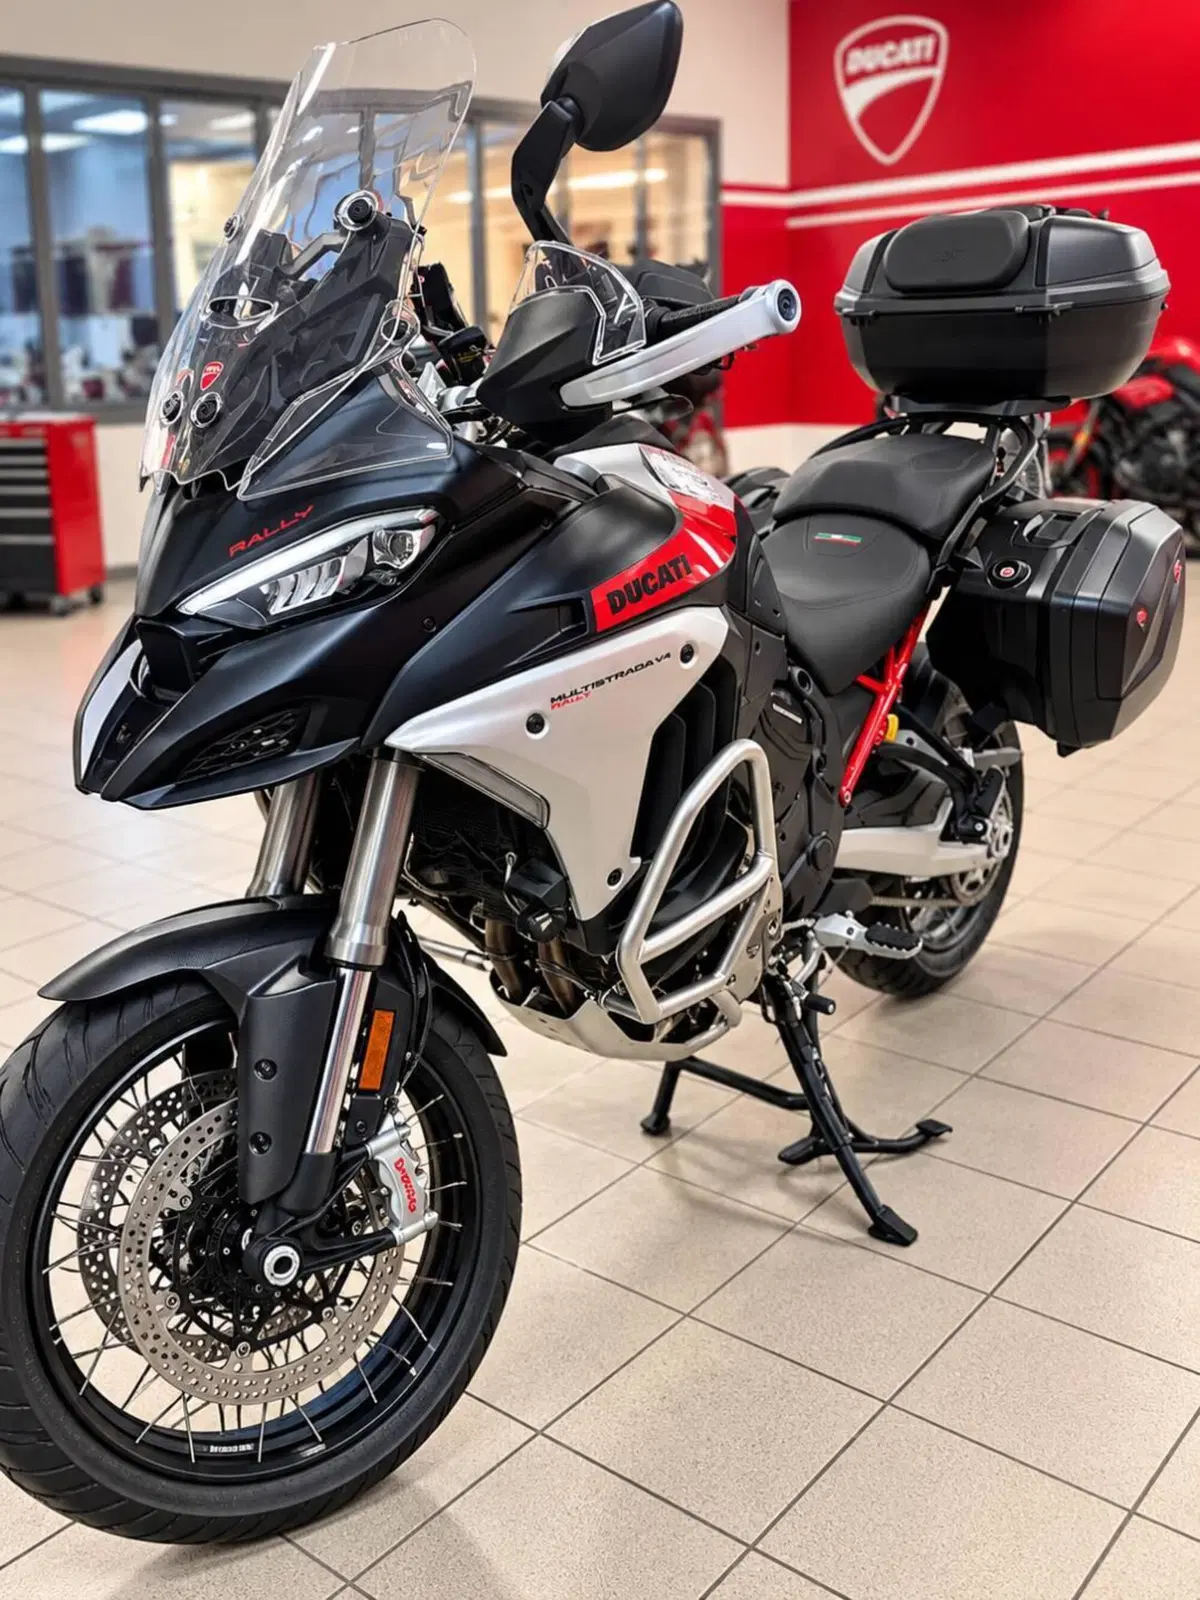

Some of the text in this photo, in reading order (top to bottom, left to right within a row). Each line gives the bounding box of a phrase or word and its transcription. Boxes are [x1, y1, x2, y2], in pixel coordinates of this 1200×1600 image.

[845, 34, 937, 76] DUCATI
[228, 504, 315, 557] RALLY
[606, 553, 693, 616] DUCATI
